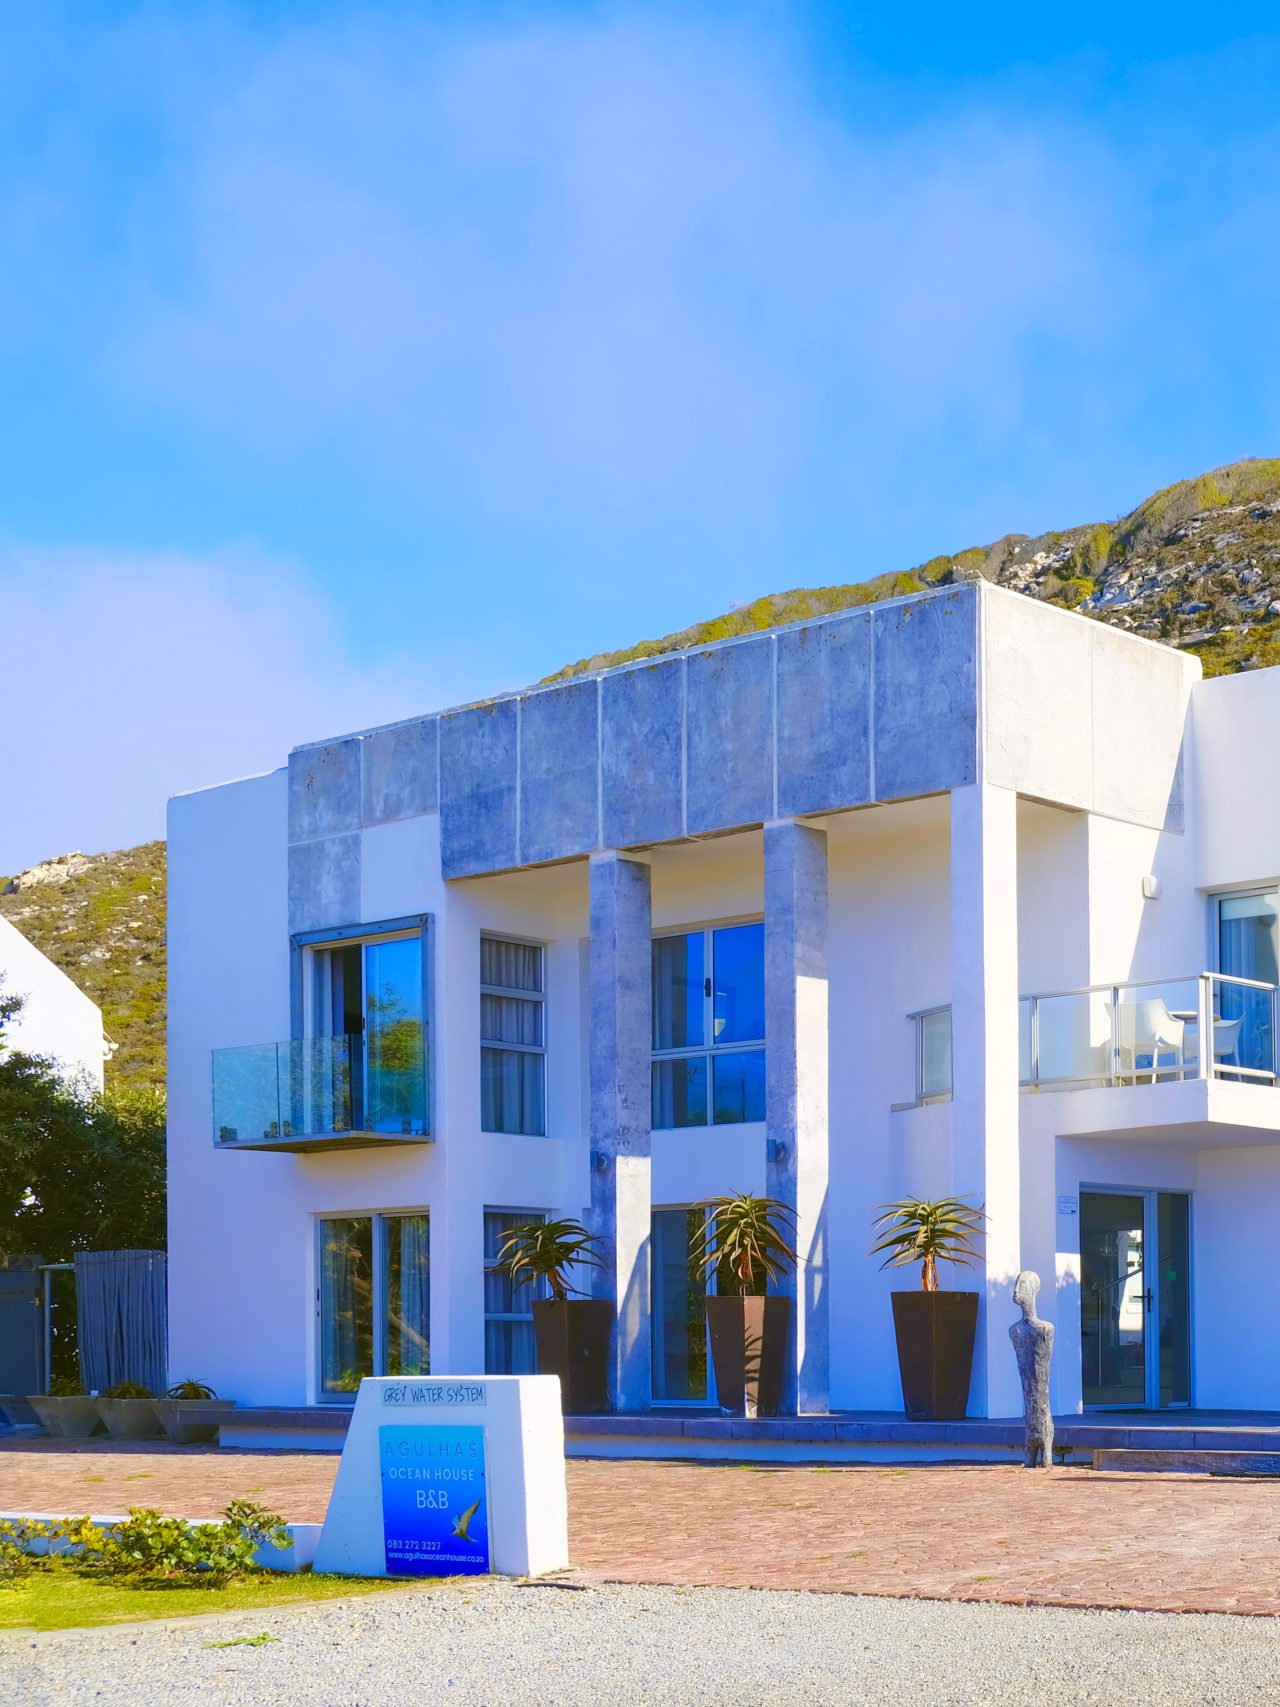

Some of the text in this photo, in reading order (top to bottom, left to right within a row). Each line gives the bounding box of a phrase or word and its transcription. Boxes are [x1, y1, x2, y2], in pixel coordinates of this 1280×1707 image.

[384, 1385, 484, 1403] GREY WATER SYSTEM
[385, 1441, 479, 1458] AGULHAS
[389, 1467, 475, 1481] OCEAN HOUSE
[416, 1489, 449, 1509] B&B
[387, 1539, 441, 1550] 083 272 3227
[388, 1551, 484, 1563] www.agulhasoceanhouse.co.za
